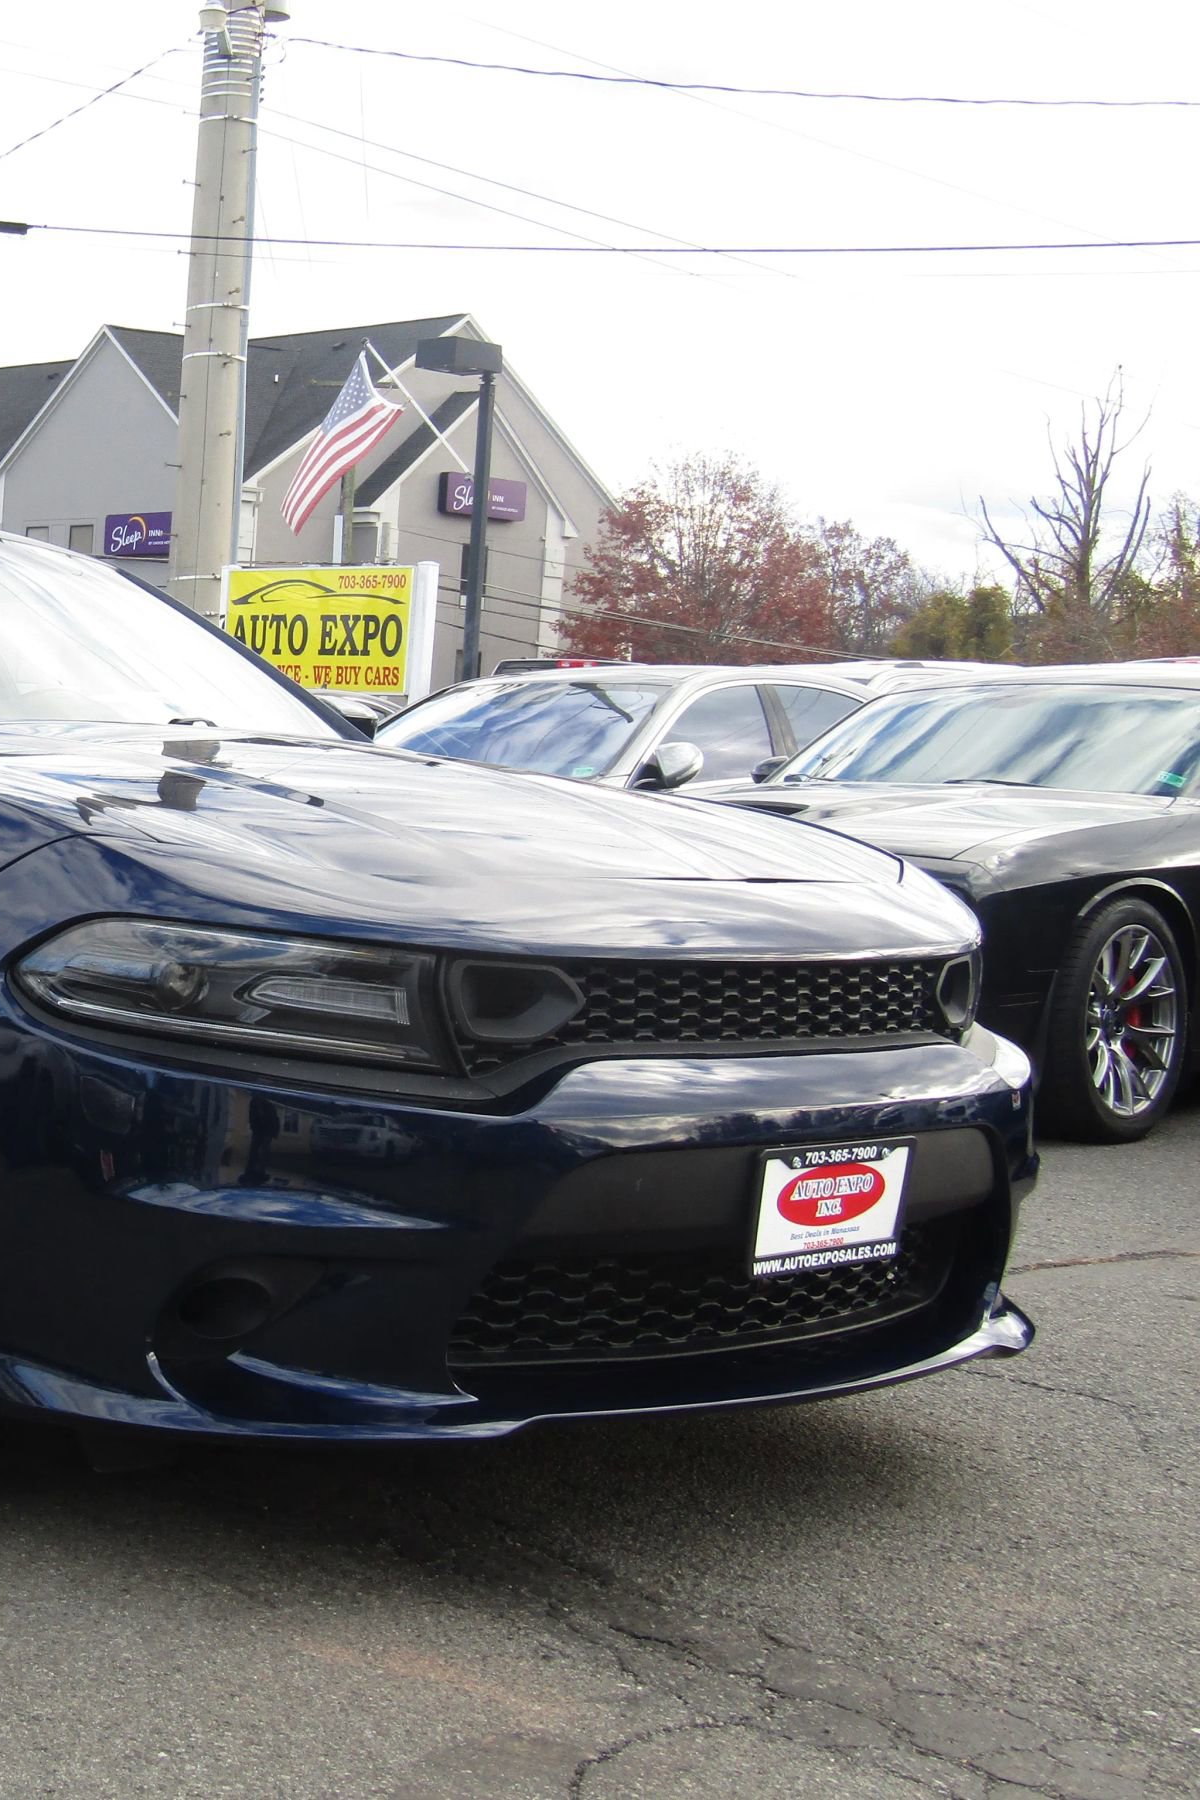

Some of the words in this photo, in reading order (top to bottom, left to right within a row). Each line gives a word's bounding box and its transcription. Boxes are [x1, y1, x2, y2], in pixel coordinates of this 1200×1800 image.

[453, 485, 473, 511] Sle
[110, 524, 142, 553] Sleep
[339, 574, 406, 589] 703-365-7900
[233, 613, 309, 656] AUTO
[317, 613, 403, 657] EXPO
[313, 665, 332, 685] WE
[335, 666, 361, 686] BUY
[364, 666, 400, 686] CARS
[805, 1146, 877, 1165] 703-365-7900
[791, 1179, 834, 1200] AUTO
[835, 1174, 874, 1194] EXPO
[816, 1199, 842, 1217] INC.
[790, 1231, 804, 1241] Best
[805, 1228, 822, 1238] Deals
[752, 1242, 897, 1276] WWW.AUTOEXPOSALES.COM
